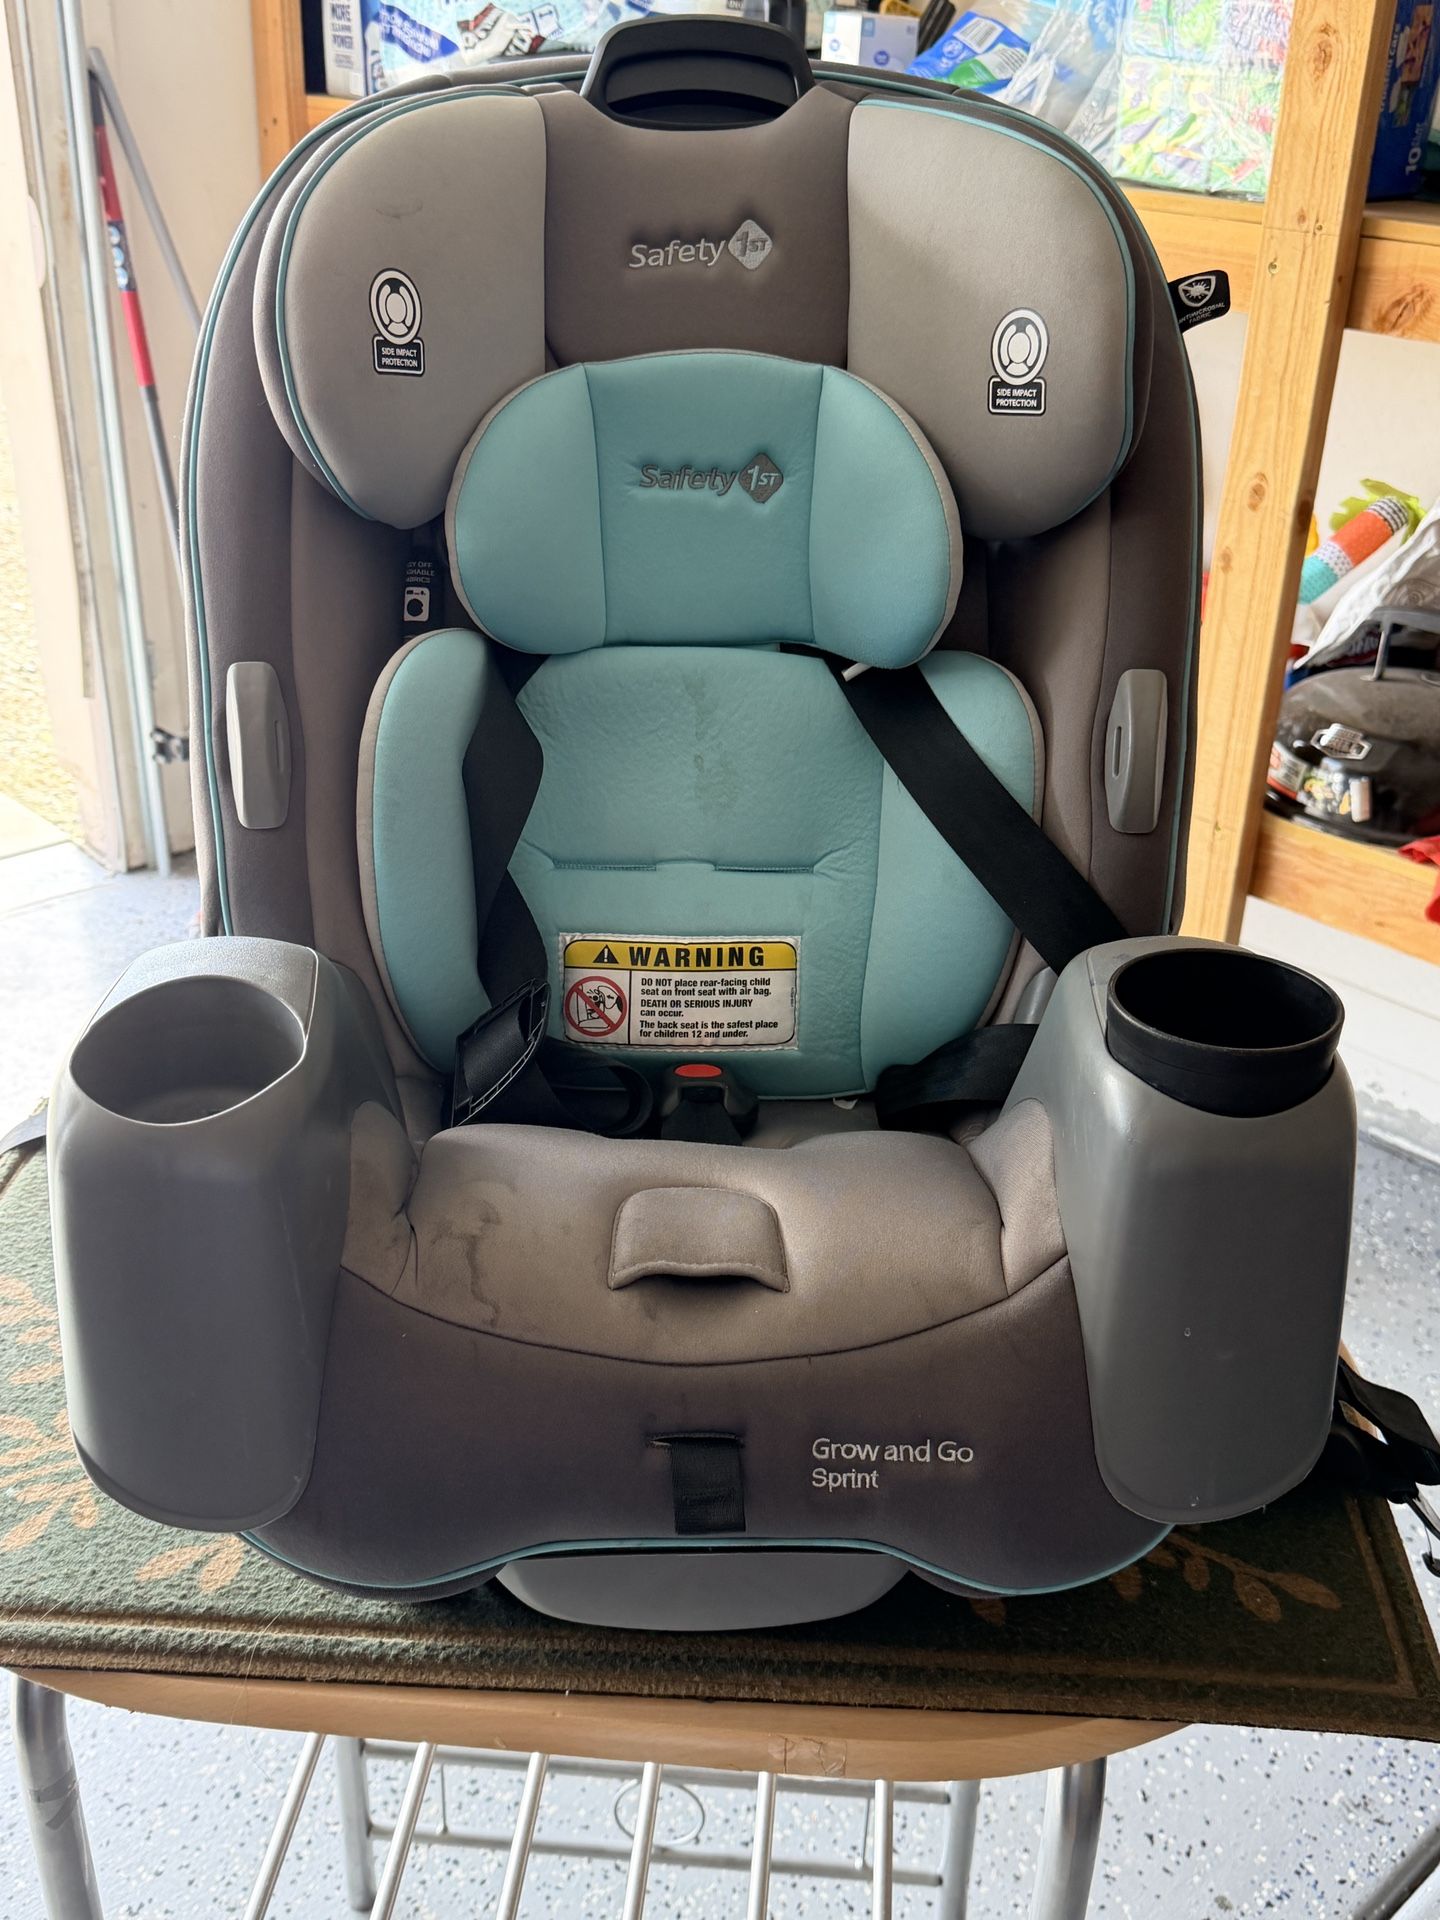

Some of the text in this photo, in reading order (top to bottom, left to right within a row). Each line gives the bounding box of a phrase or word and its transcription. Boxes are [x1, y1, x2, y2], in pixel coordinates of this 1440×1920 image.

[629, 238, 727, 268] Safety
[381, 347, 417, 358] SIDE IMPACT
[381, 357, 418, 367] PROTECTION
[996, 388, 1037, 398] SIDE IMPACT
[996, 399, 1037, 408] PROTECTION
[639, 464, 780, 497] Safety 1ST
[628, 946, 765, 968] WARNING
[641, 977, 771, 989] DO NOT place rear-facing child
[640, 988, 659, 996] seat
[674, 987, 696, 996] front
[698, 988, 716, 996] seat
[719, 987, 737, 996] with
[740, 987, 751, 995] air
[753, 987, 772, 997] bag.
[640, 999, 754, 1008] DEATH OR SERIOUS INJURY
[640, 1009, 684, 1018] can occur.
[640, 1020, 779, 1030] The back seat is the safest place
[640, 1029, 749, 1038] for children 12 and under.
[812, 1438, 974, 1463] Grow and Go
[811, 1467, 880, 1492] Sprint
